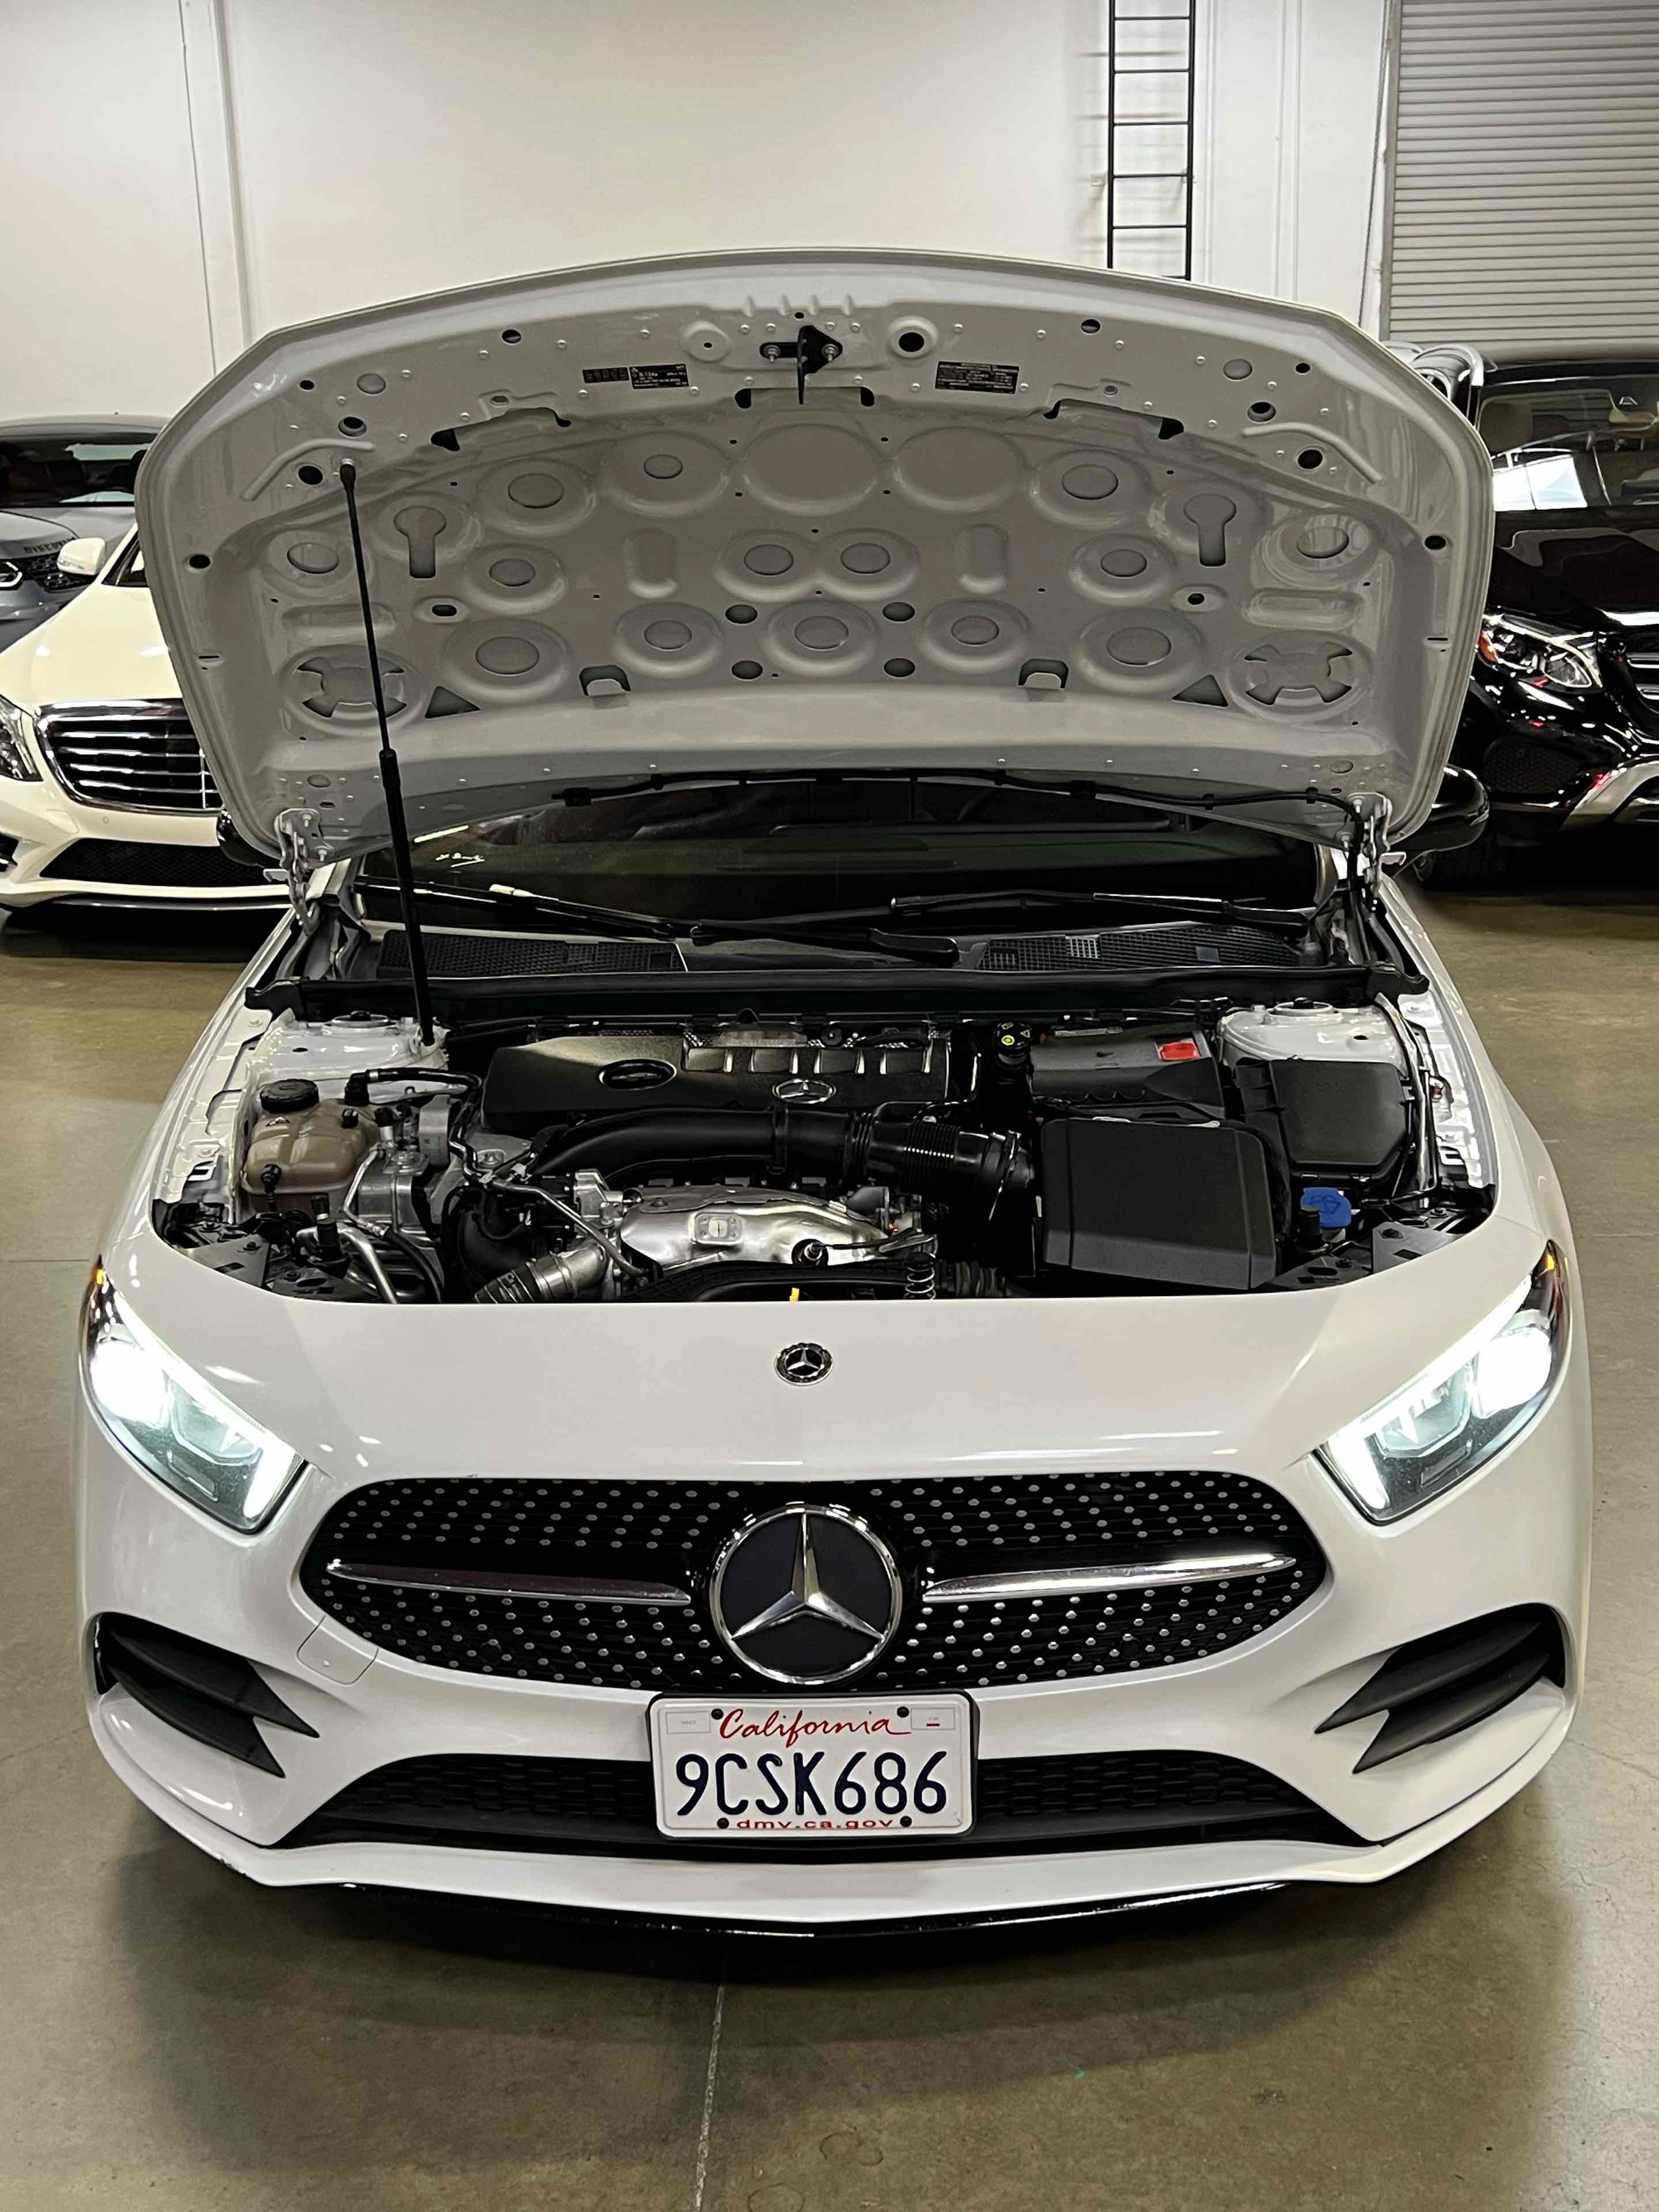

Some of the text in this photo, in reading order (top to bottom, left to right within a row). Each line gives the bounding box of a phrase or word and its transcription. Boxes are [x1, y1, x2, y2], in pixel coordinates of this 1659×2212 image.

[719, 1709, 911, 1748] California
[676, 1751, 947, 1816] 9CSK686
[737, 1819, 894, 1830] dmv.ca.gov
